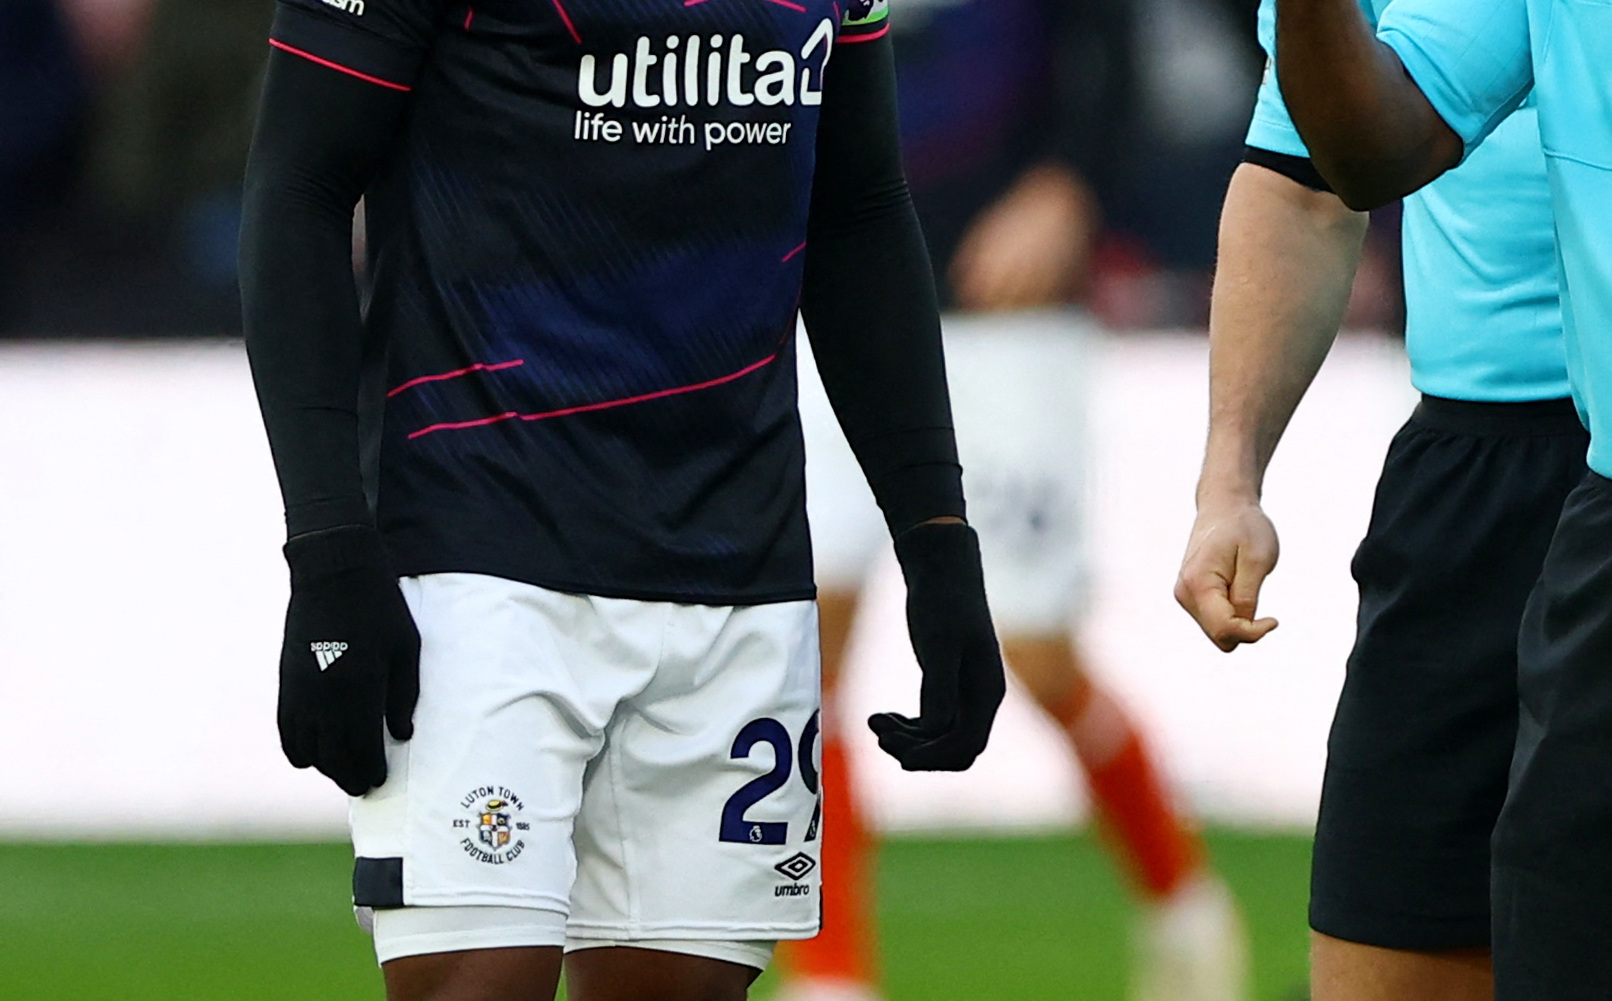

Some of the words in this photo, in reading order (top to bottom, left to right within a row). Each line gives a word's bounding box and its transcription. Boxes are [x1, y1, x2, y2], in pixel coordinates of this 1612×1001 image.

[578, 34, 795, 107] utilita
[574, 110, 623, 141] life
[632, 114, 695, 144] with
[704, 121, 792, 150] power
[460, 786, 494, 809] LUTON
[499, 786, 524, 811] TOWN
[453, 819, 471, 828] EST
[460, 837, 504, 865] FOOTBALL
[506, 839, 525, 861] CLUB
[774, 882, 810, 897] umbro
